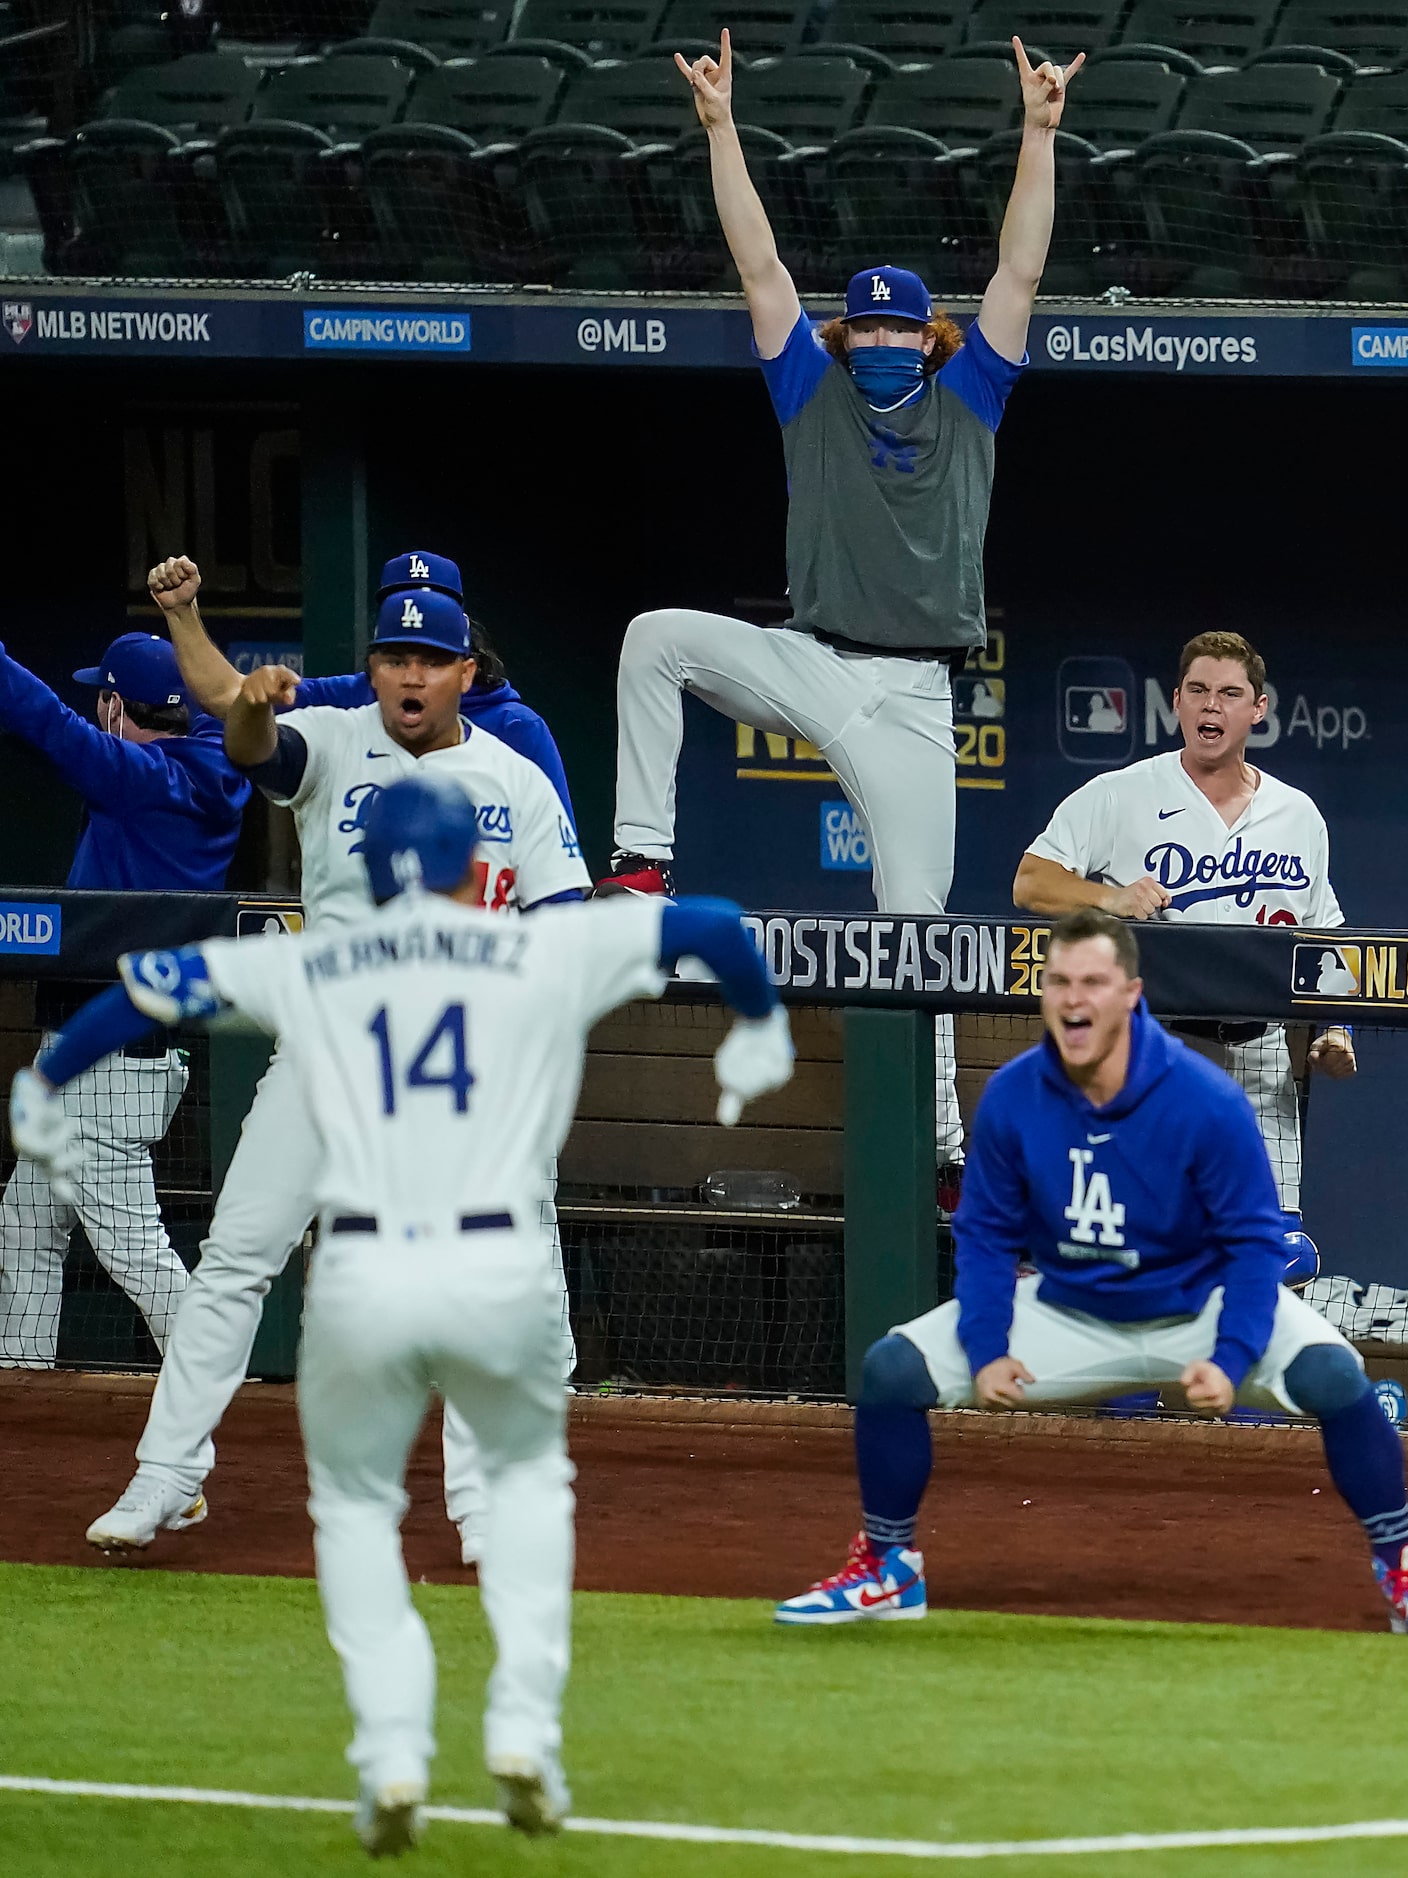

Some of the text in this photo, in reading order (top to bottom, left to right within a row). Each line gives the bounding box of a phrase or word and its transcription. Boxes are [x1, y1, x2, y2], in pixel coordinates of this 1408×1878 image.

[871, 275, 891, 301] LA
[37, 310, 211, 341] MLB NETWORK
[309, 317, 465, 344] CAMPING WORLD
[577, 318, 667, 353] @MLB
[1046, 325, 1257, 371] @LasMayores
[409, 554, 430, 579] LA
[402, 598, 424, 629] LA
[1287, 694, 1367, 749] App
[1144, 837, 1311, 909] Dodgers
[368, 1002, 476, 1116] 14
[1064, 1147, 1126, 1247] LA
